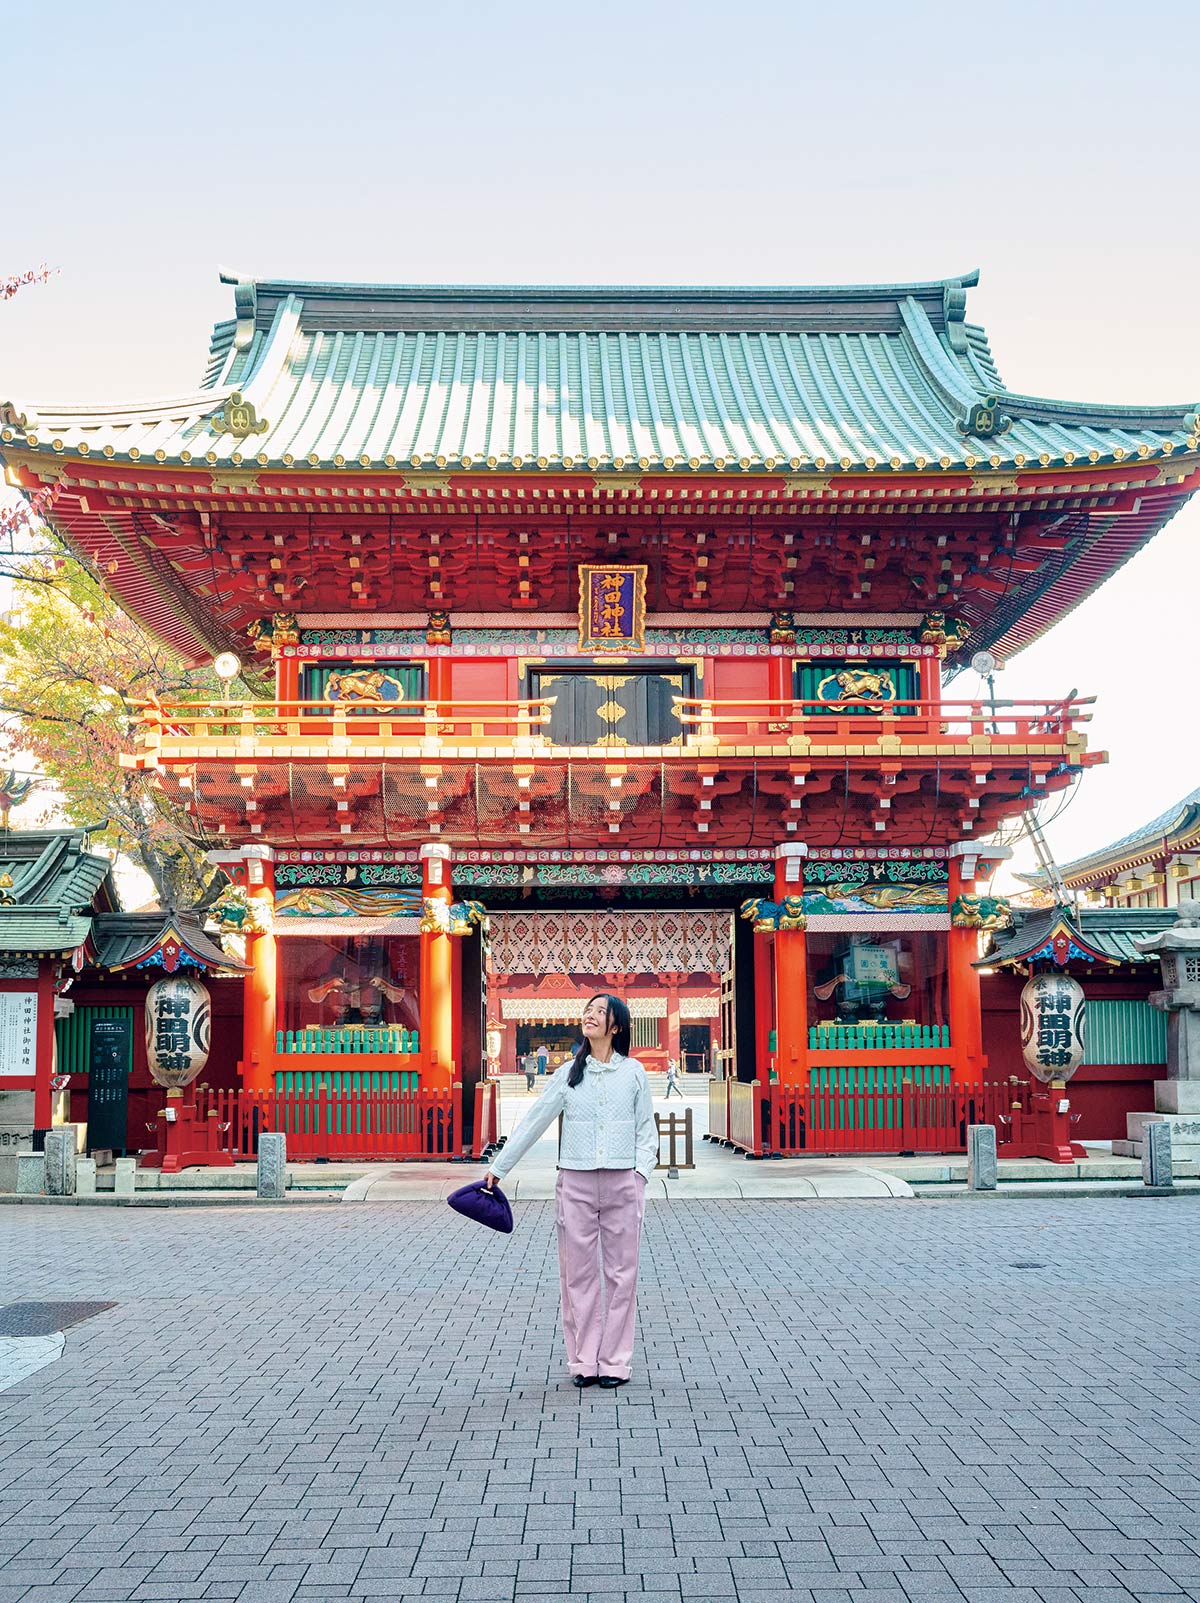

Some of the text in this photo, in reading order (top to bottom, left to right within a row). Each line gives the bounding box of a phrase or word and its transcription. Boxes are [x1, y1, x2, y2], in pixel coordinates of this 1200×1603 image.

[600, 573, 625, 637] 神田神社
[154, 994, 192, 1071] 神田明神
[1034, 991, 1073, 1067] 神田明神
